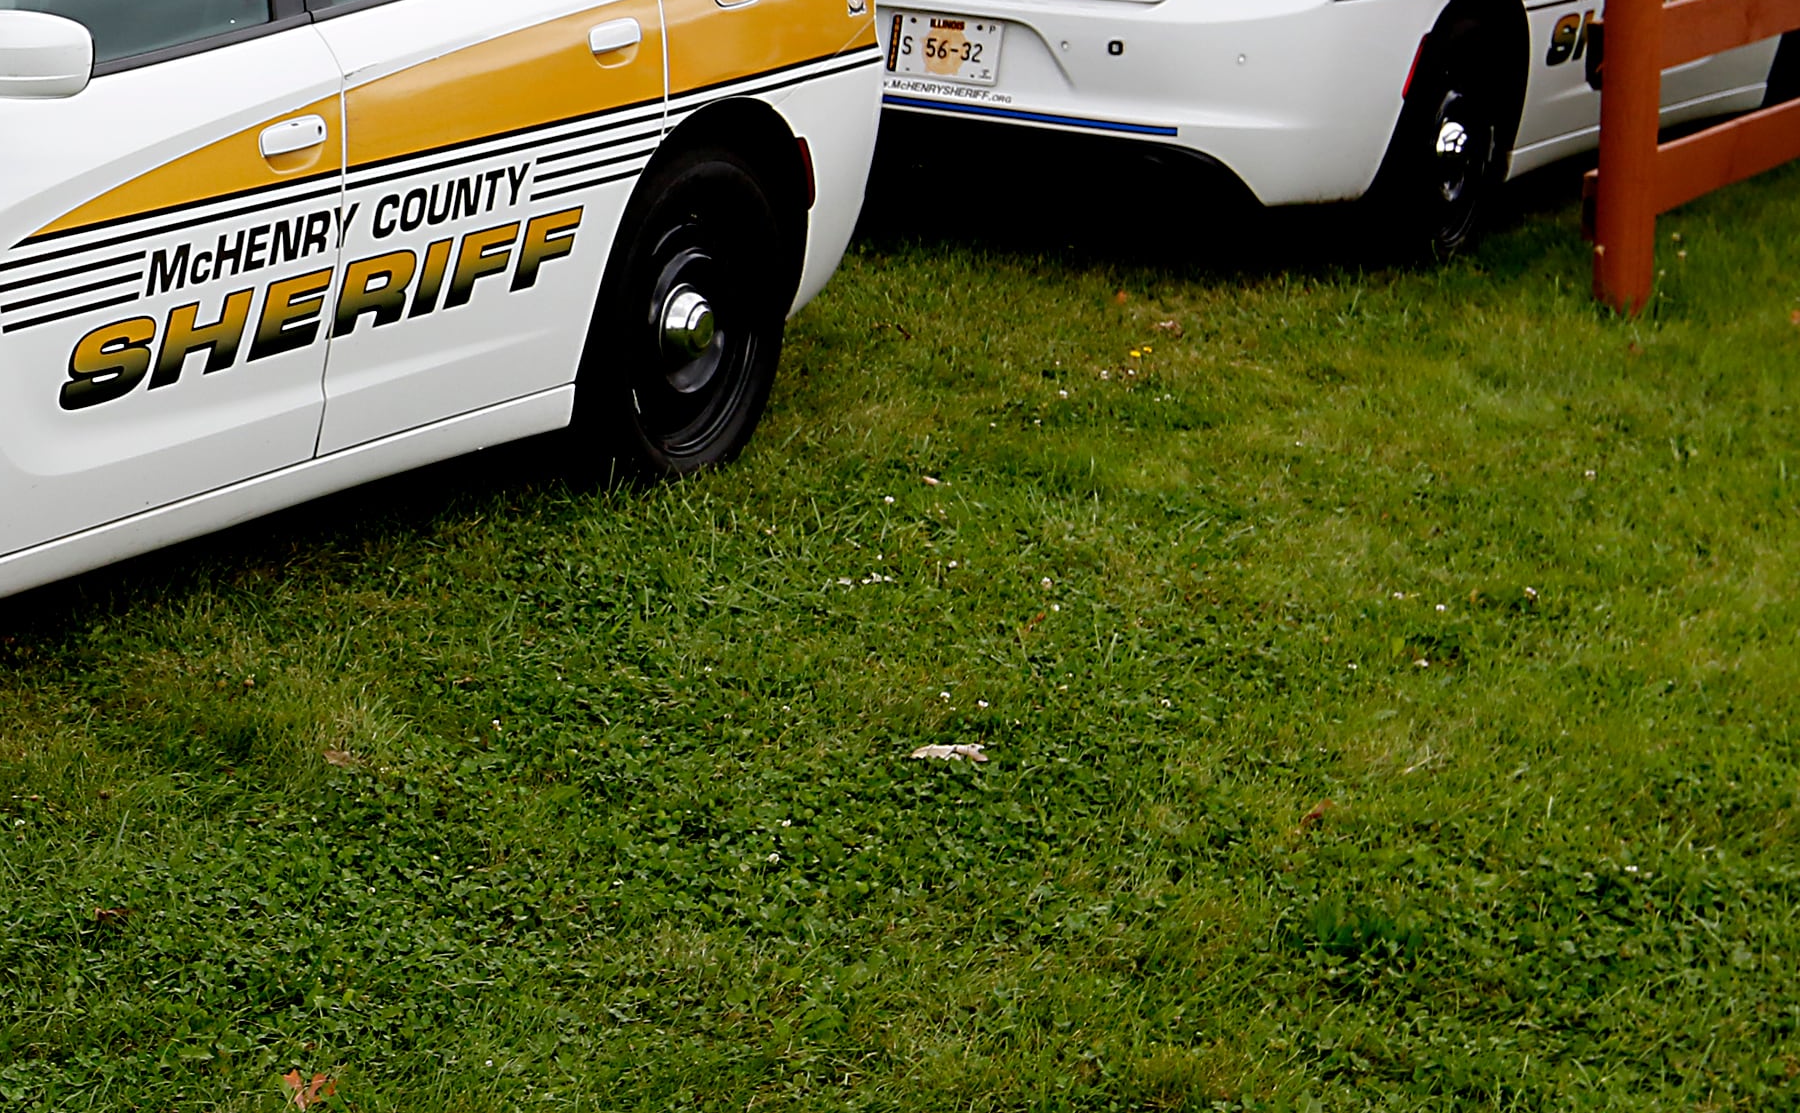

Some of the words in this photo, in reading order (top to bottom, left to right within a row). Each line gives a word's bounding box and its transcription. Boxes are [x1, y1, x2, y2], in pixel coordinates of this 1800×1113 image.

[901, 35, 914, 55] S
[925, 37, 983, 63] 56-32
[929, 18, 965, 31] ILLINOIS
[145, 202, 361, 297] McHENRY
[372, 161, 532, 241] COUNTY
[58, 205, 584, 411] SHERIFF
